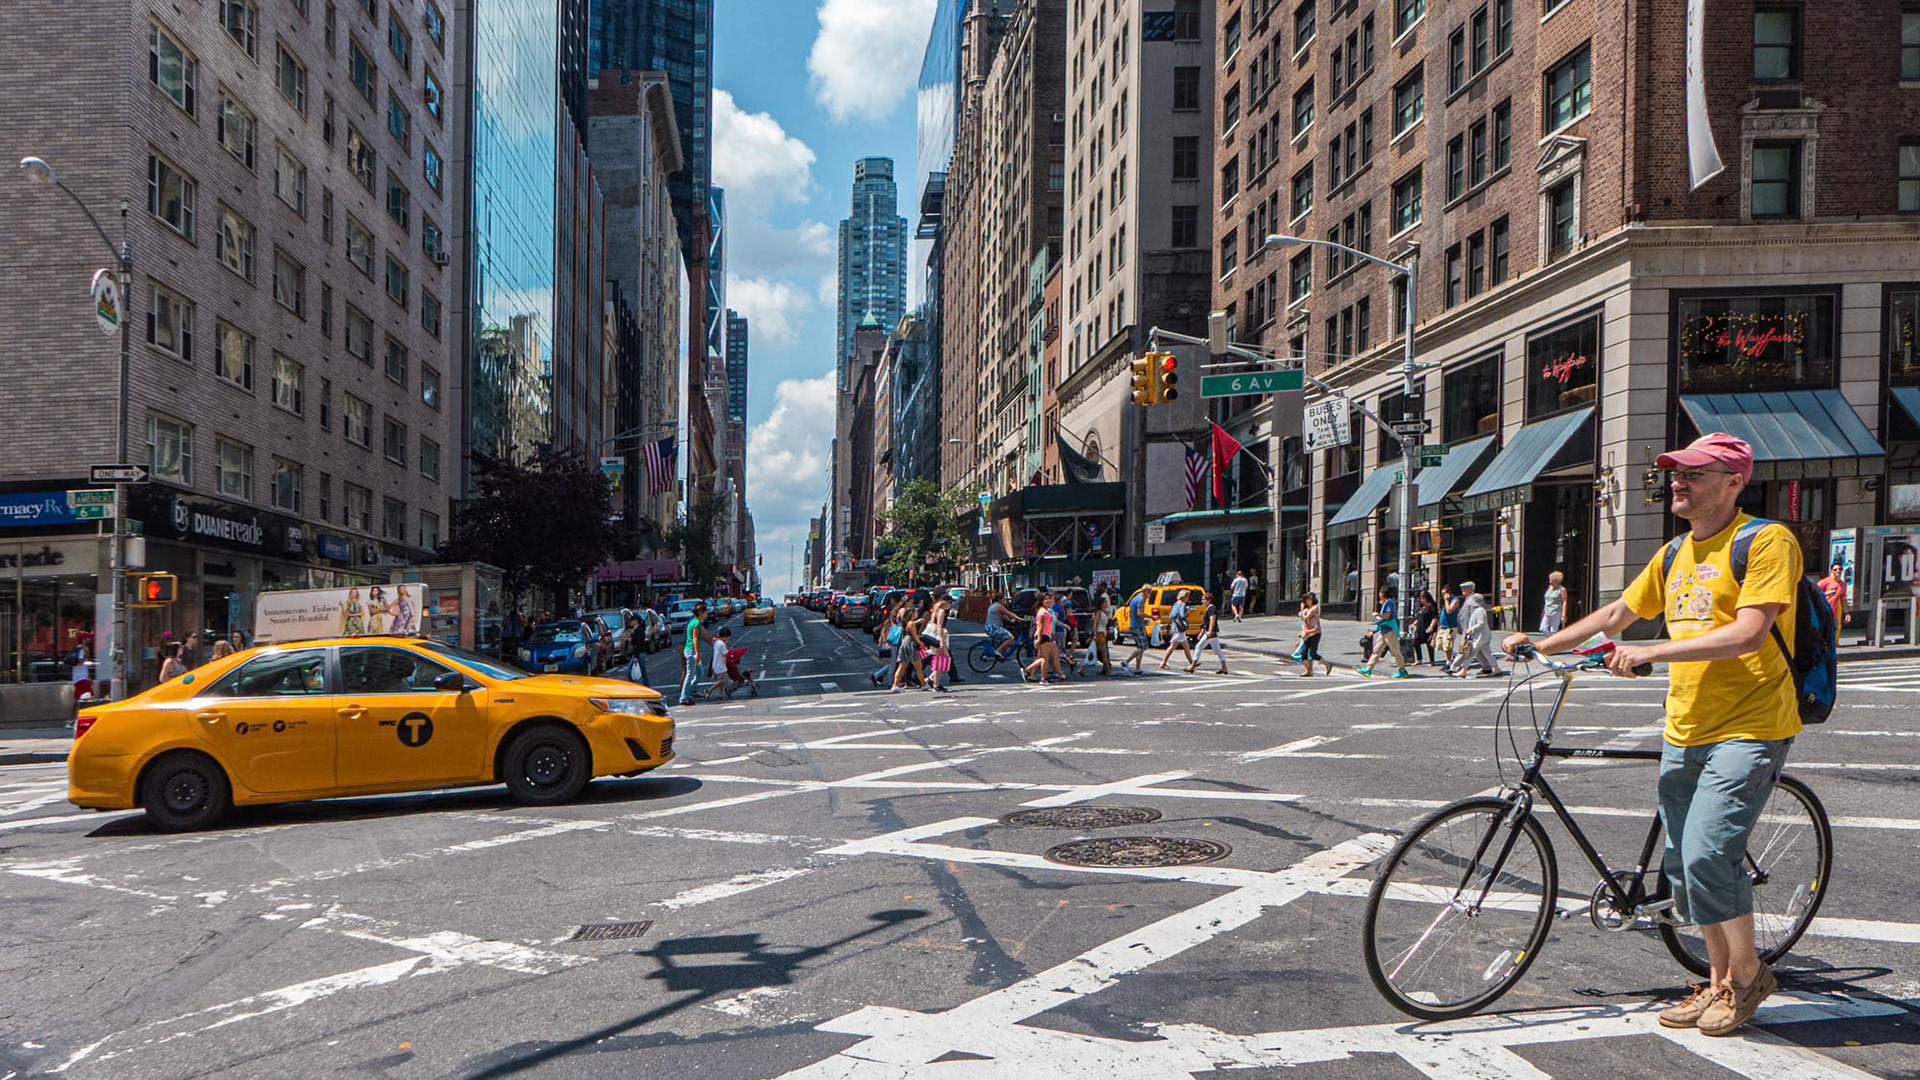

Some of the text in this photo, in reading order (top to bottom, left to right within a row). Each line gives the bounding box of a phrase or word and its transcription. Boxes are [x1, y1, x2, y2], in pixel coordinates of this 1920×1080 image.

[1231, 378, 1242, 391] 6
[1309, 401, 1343, 418] BUSES
[1312, 412, 1339, 428] ONLY
[1427, 458, 1432, 466] 6
[98, 470, 141, 478] ONE WAY
[80, 508, 88, 518] 6
[1572, 749, 1604, 758] BIRIA
